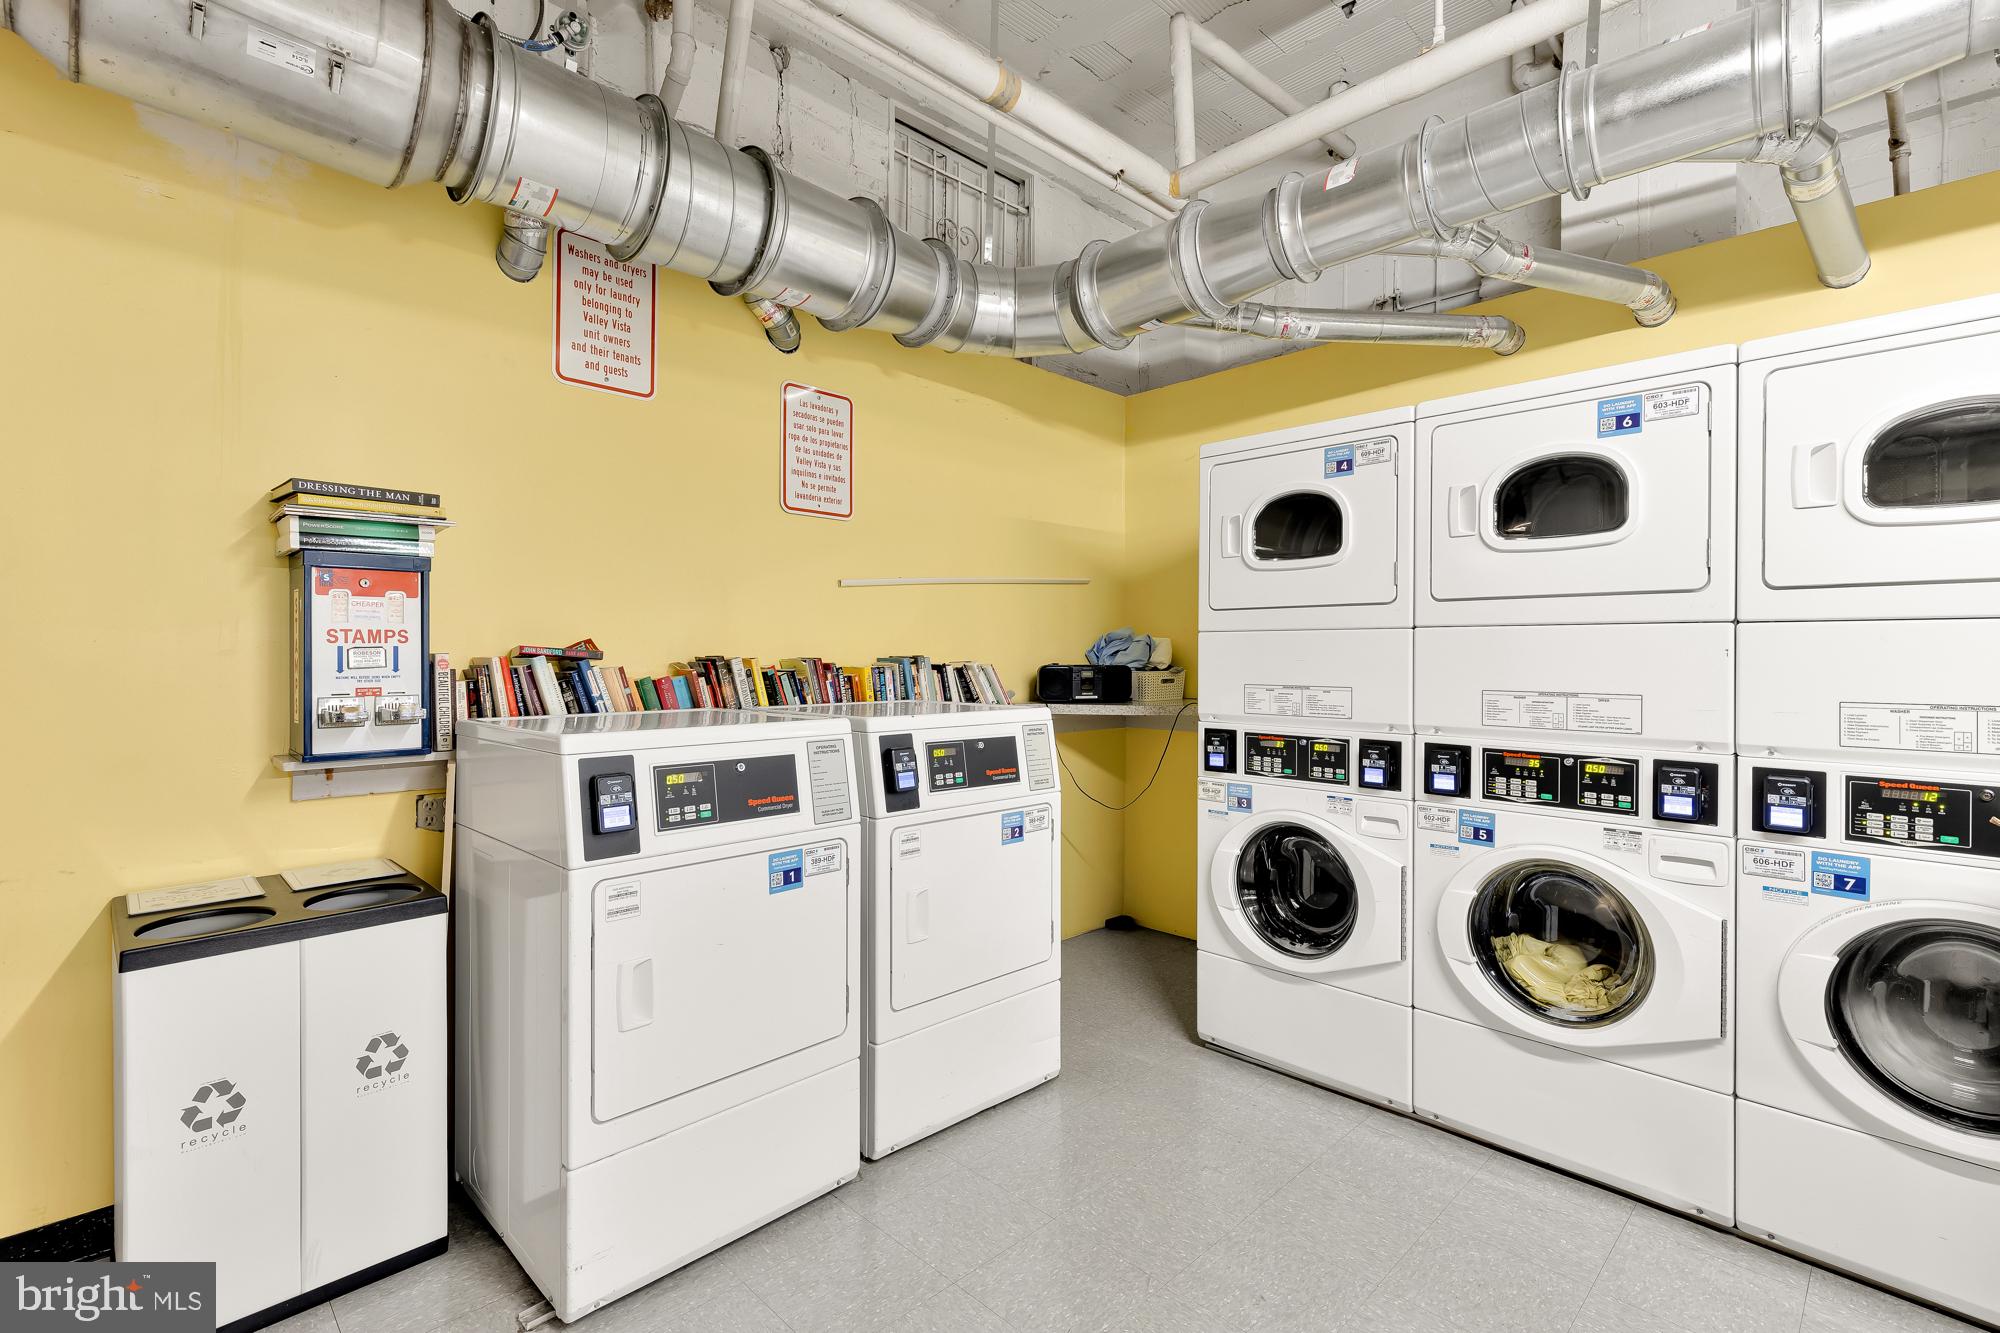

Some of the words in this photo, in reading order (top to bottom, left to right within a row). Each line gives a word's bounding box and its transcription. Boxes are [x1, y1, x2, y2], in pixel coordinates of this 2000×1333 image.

[568, 244, 600, 264] Washers
[604, 257, 618, 269] and
[622, 262, 647, 278] dryers
[582, 266, 602, 280] may
[603, 271, 612, 282] be
[616, 276, 632, 288] used
[574, 279, 592, 294] only
[596, 284, 606, 296] for
[610, 288, 640, 308] laundry
[582, 296, 621, 317] belonging
[625, 308, 632, 319] to
[583, 311, 608, 329] Valley
[612, 319, 630, 333] Vista
[584, 329, 600, 340] unit
[604, 334, 630, 348] owners
[572, 340, 586, 353] and
[591, 344, 609, 358] their
[613, 350, 641, 366] tenants
[585, 360, 599, 371] and
[604, 365, 628, 378] guests
[800, 399, 808, 409] Las
[810, 401, 834, 414] lavadoras
[1653, 399, 1689, 409] 603-HDF
[793, 410, 818, 422] secadoras
[827, 417, 844, 428] pueden
[1623, 416, 1632, 427] 6
[807, 424, 816, 433] solo
[818, 428, 829, 436] para
[832, 428, 844, 439] lavar
[788, 432, 800, 441] ropa
[820, 439, 848, 451] propietarios
[813, 448, 834, 459] unidades
[837, 452, 842, 460] de
[796, 456, 812, 468] Valley
[814, 459, 826, 470] Vista
[1341, 461, 1347, 470] 4
[792, 468, 816, 479] inquilinos
[824, 473, 845, 484] invitados
[298, 481, 356, 495] DRESSING
[358, 488, 381, 498] THE
[385, 491, 410, 502] MAN
[802, 480, 808, 489] No
[818, 484, 836, 493] permite
[824, 494, 842, 505] exterior
[326, 629, 408, 644] STAMPS
[438, 671, 450, 705] BEAUTIFUL
[438, 706, 450, 737] CHILDREN
[748, 796, 770, 806] Speed
[772, 795, 794, 803] Queen
[1241, 799, 1247, 808] 3
[1924, 792, 1938, 802] 12
[1014, 828, 1019, 836] 2
[1479, 830, 1487, 840] 5
[1753, 858, 1795, 868] 606-HDF
[790, 871, 794, 882] 1
[1844, 878, 1856, 890] 7
[356, 1073, 410, 1094] recycle
[181, 1124, 246, 1149] recycle
